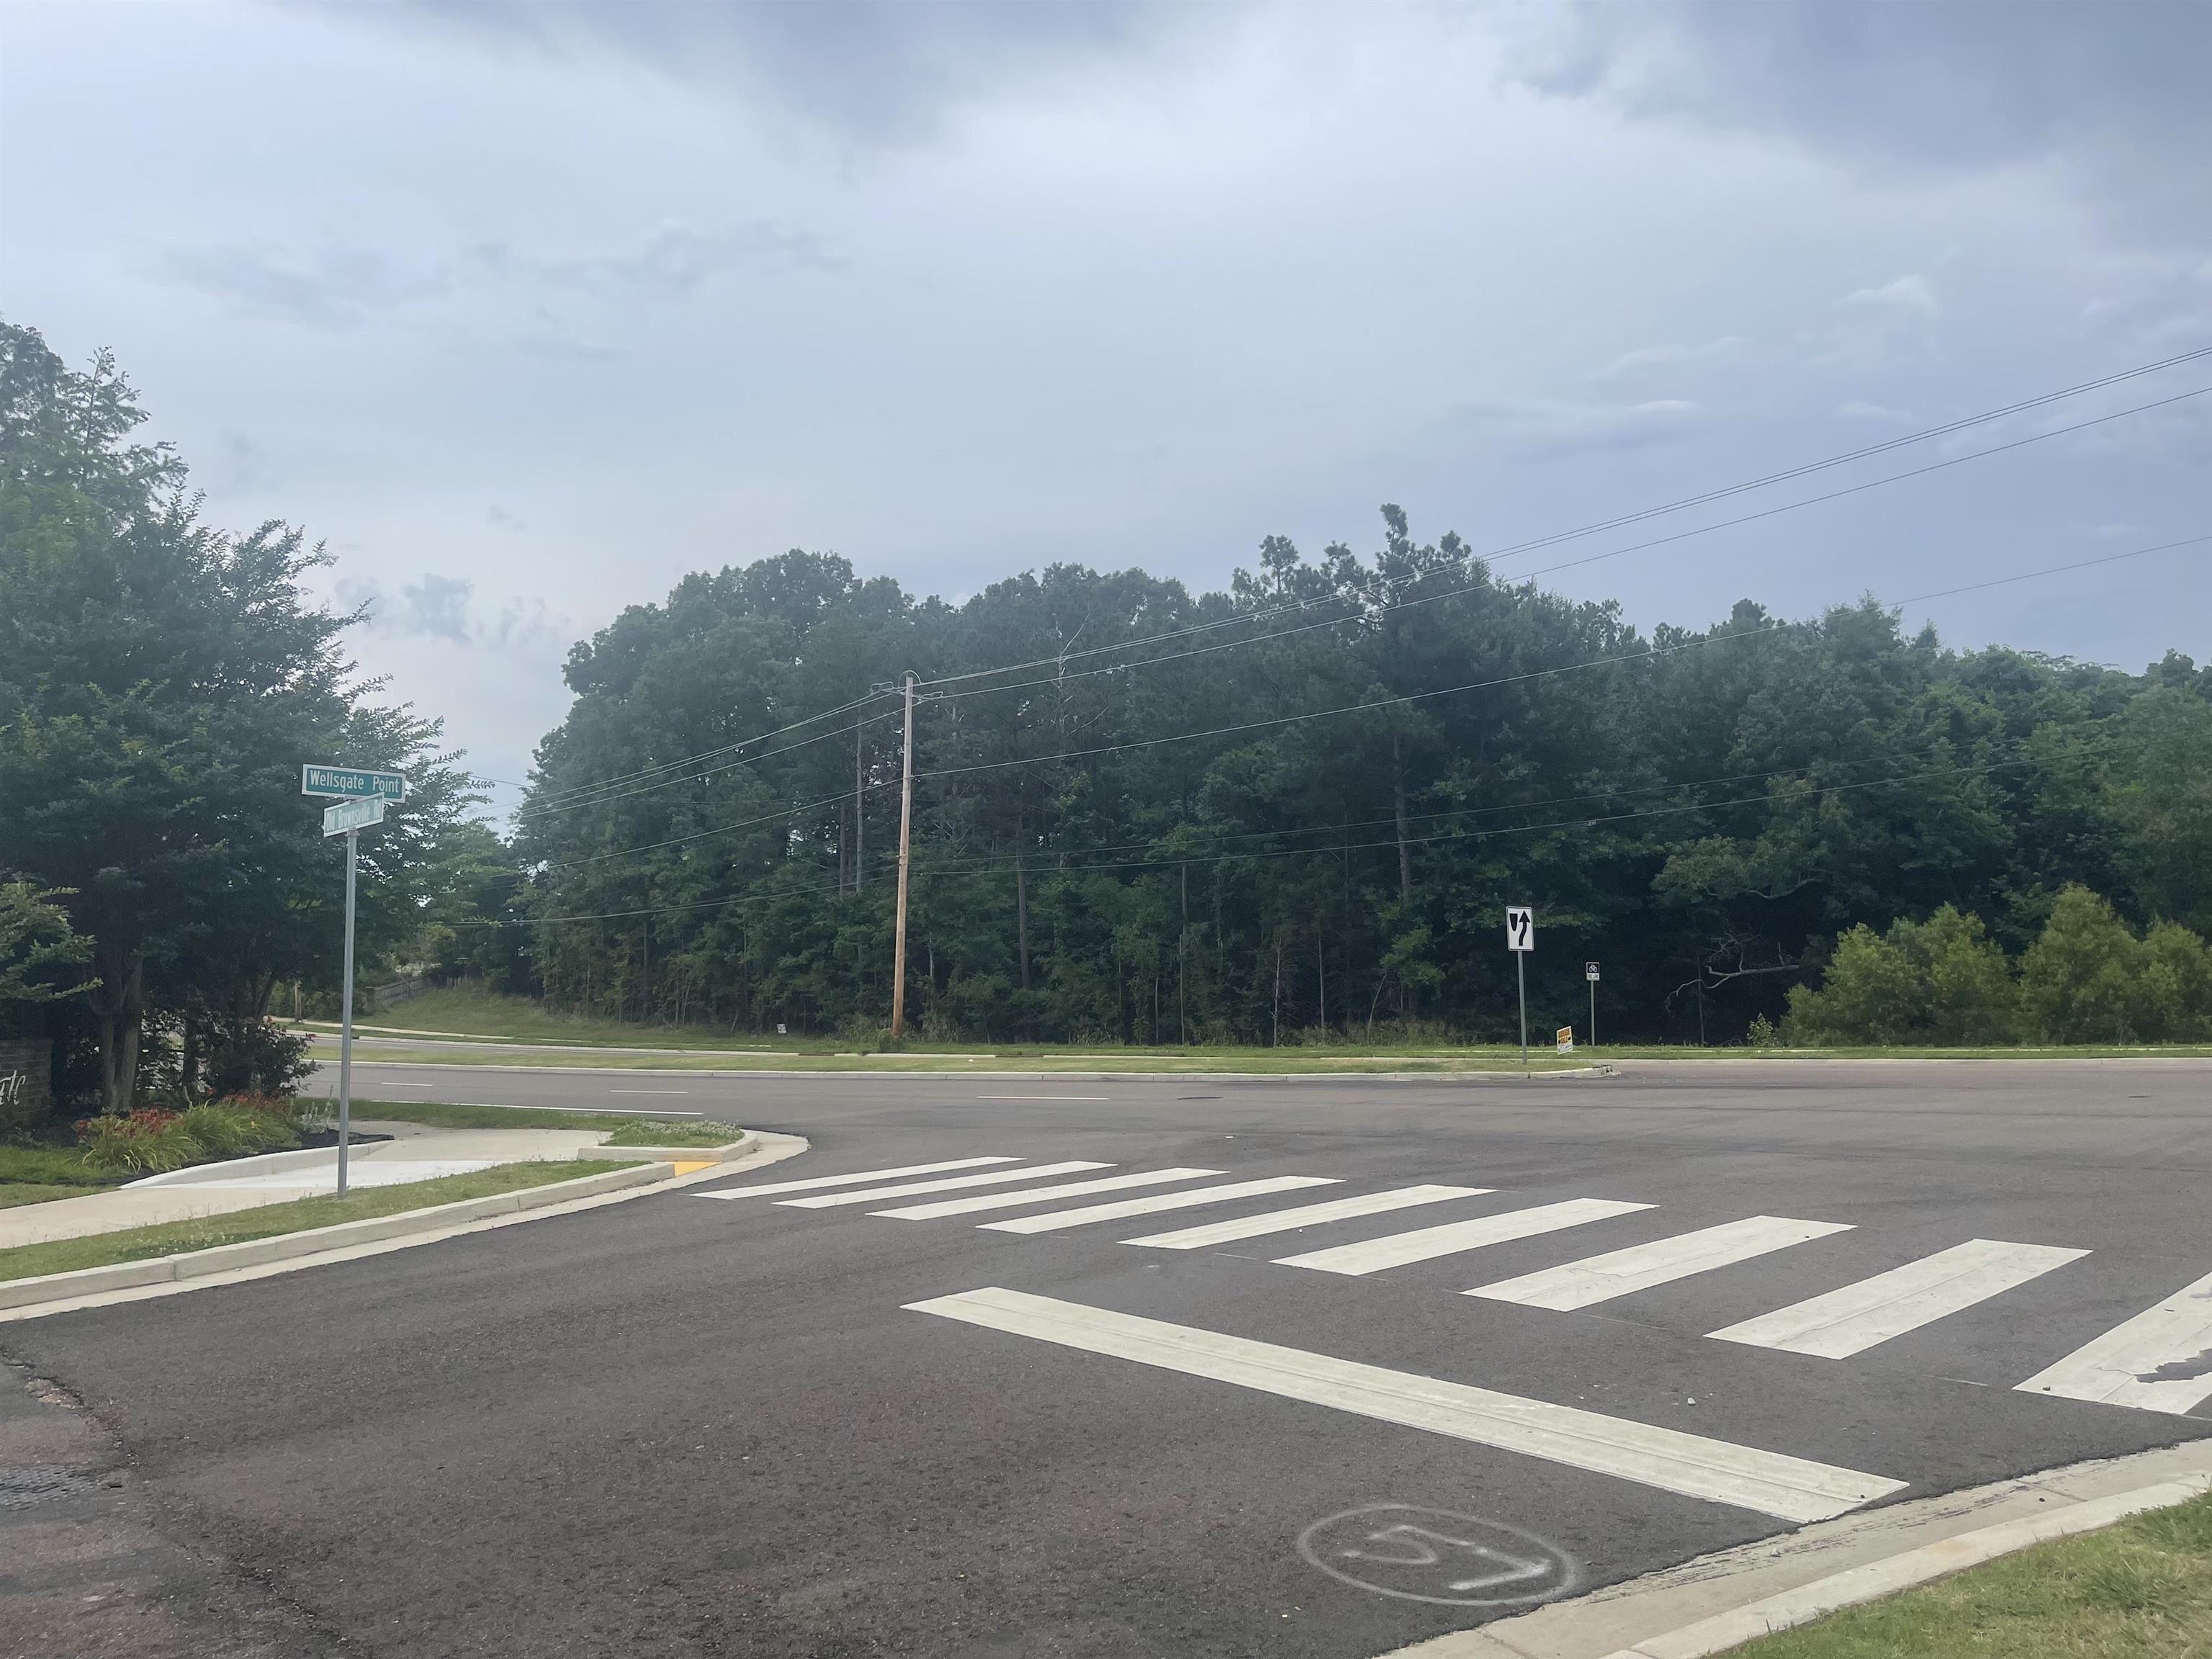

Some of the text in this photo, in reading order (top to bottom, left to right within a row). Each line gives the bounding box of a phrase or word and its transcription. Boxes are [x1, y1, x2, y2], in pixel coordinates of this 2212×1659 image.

[310, 770, 400, 793] Wellsgate Point
[326, 799, 382, 832] Old Brownsville Rd
